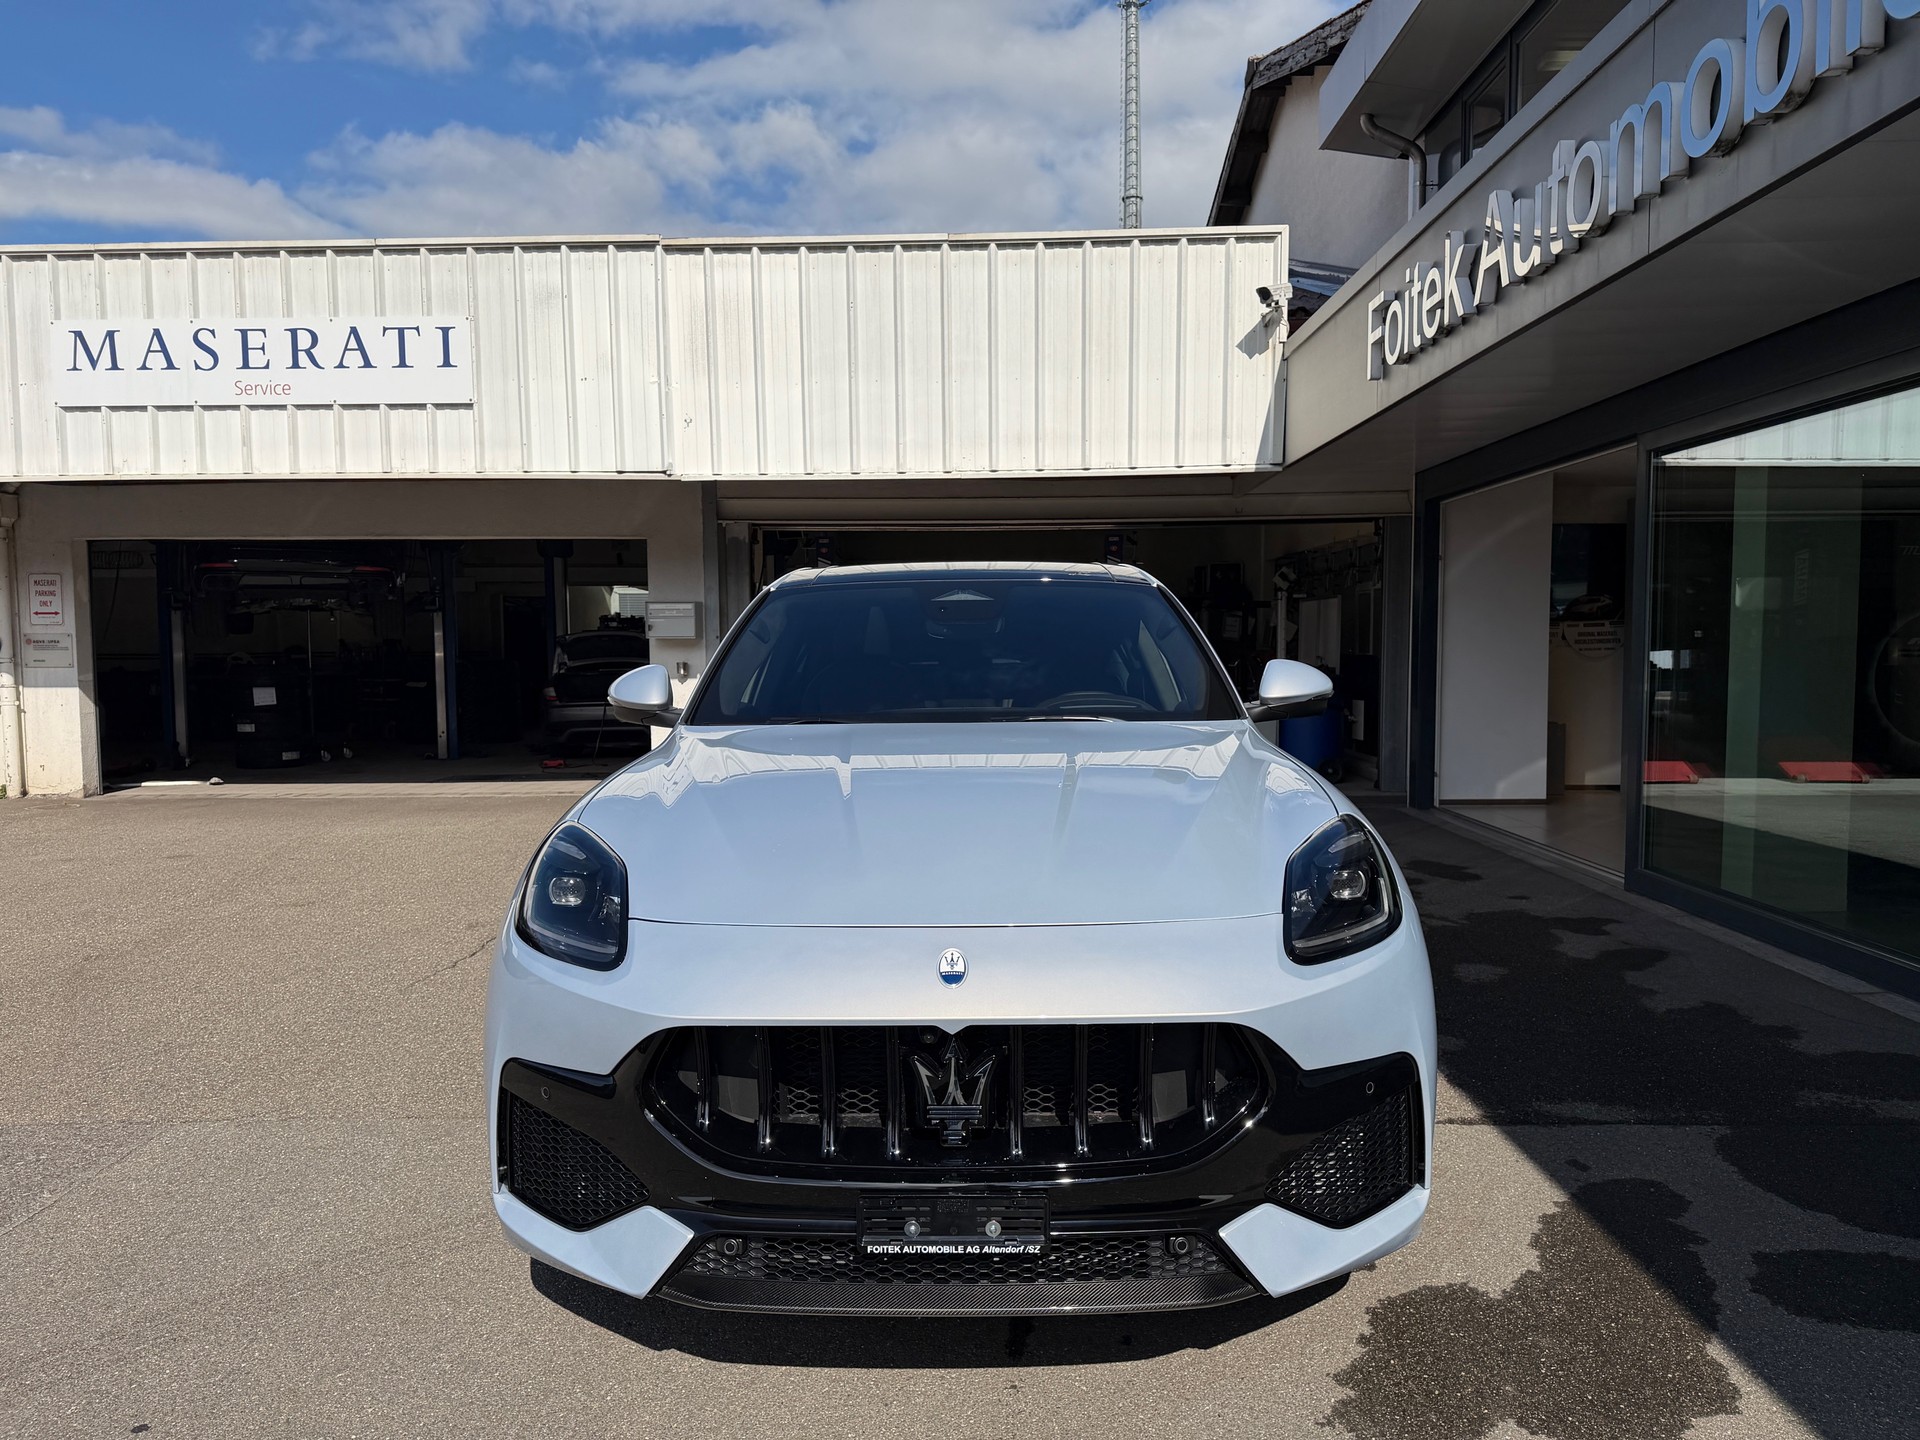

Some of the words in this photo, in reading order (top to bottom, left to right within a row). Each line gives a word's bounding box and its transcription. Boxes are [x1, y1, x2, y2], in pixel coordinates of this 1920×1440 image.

[1367, 230, 1477, 381] Foitek
[1473, 0, 1920, 307] Automob
[66, 325, 458, 372] MASERATI
[234, 379, 292, 396] Service
[33, 579, 57, 587] MASERATI
[34, 589, 57, 597] PARKING
[39, 600, 53, 608] ONLY
[867, 1245, 901, 1254] FOITEK
[902, 1245, 964, 1254] AUTOMOBILE
[965, 1245, 980, 1254] AG
[982, 1245, 1024, 1254] Altendorf
[1025, 1245, 1041, 1254] /SZ
